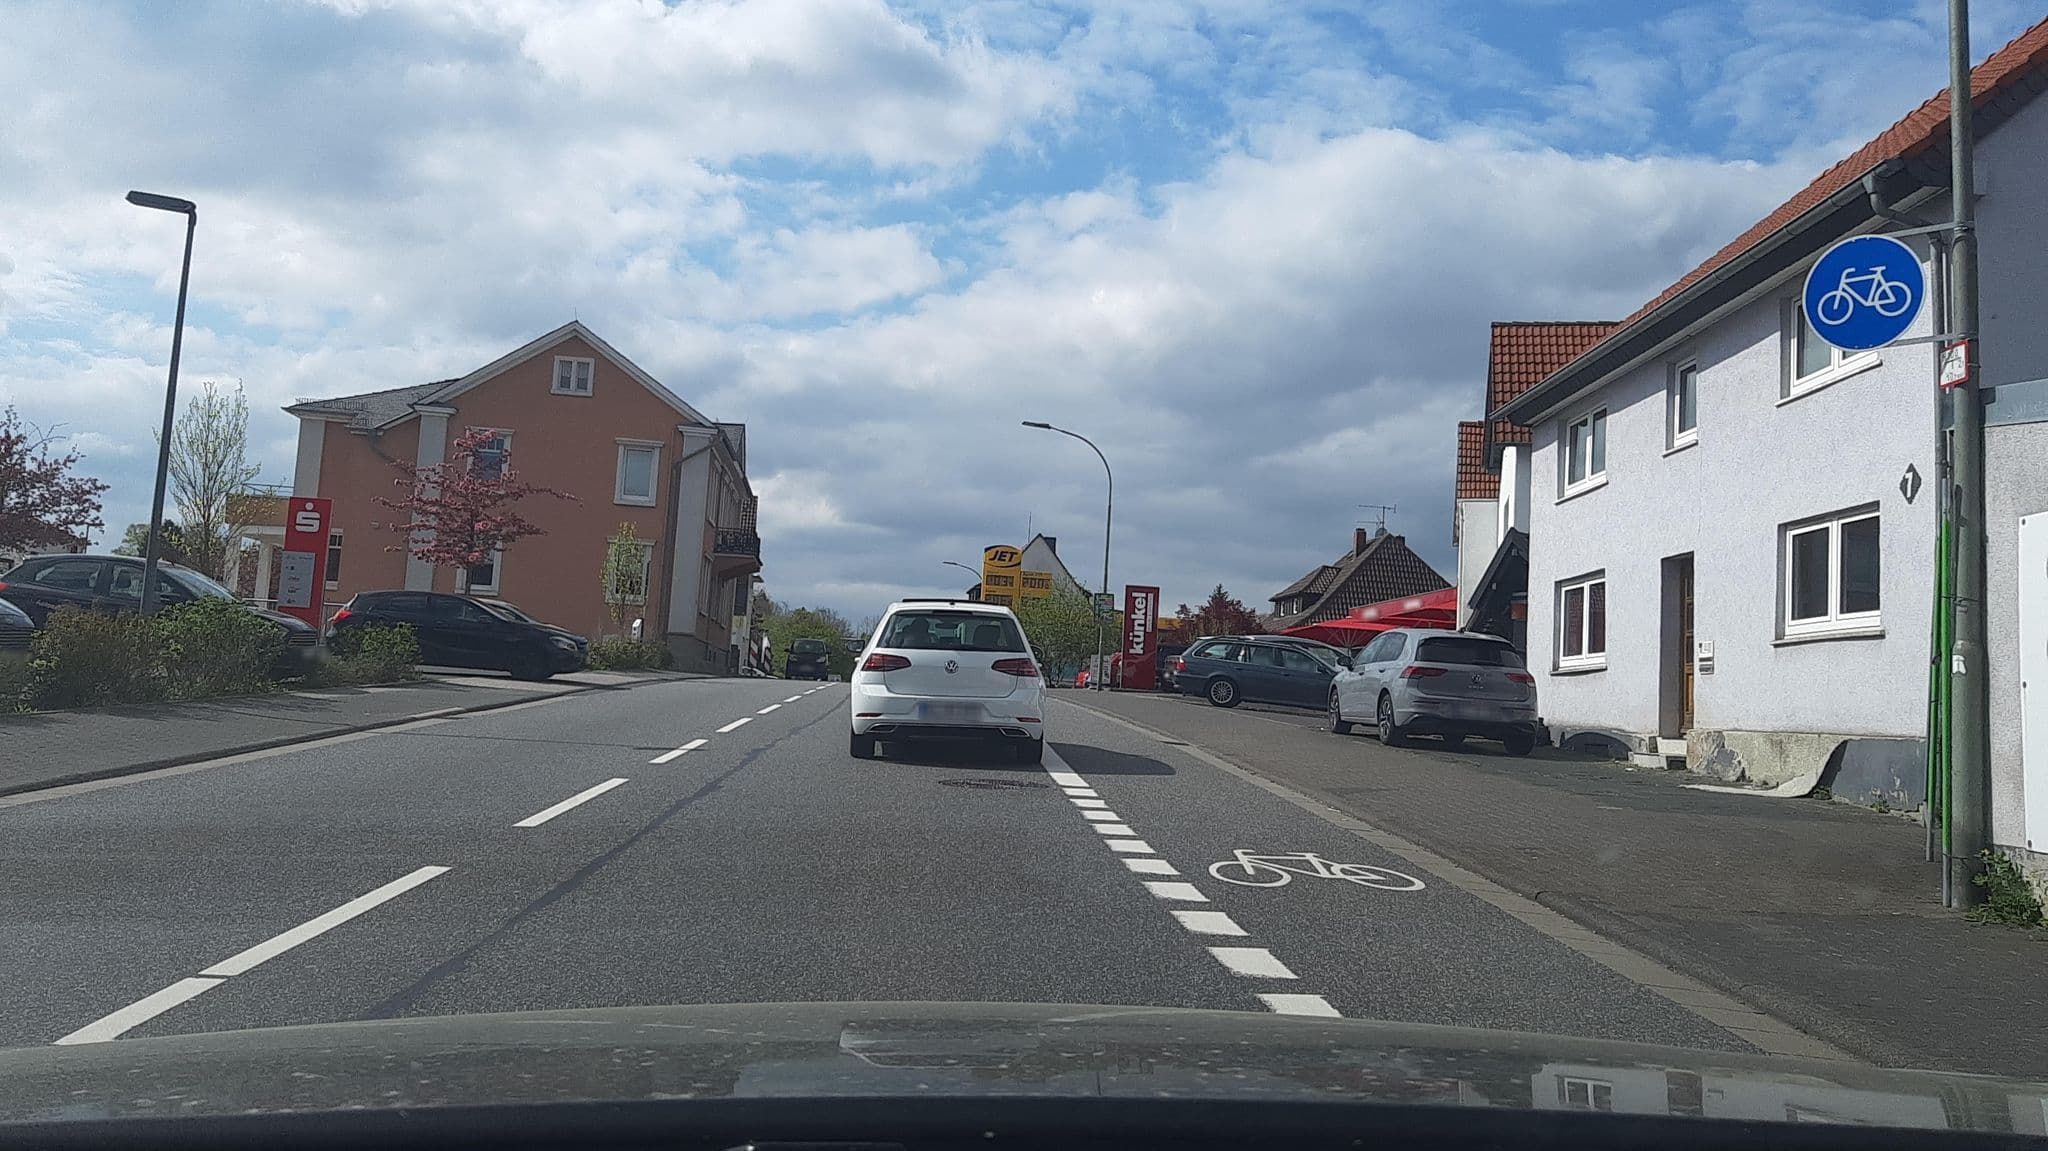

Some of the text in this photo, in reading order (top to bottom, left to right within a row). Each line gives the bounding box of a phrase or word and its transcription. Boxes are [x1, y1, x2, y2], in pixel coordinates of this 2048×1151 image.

[1905, 471, 1914, 498] 1
[988, 550, 1019, 563] JET
[1129, 592, 1147, 655] künkel
